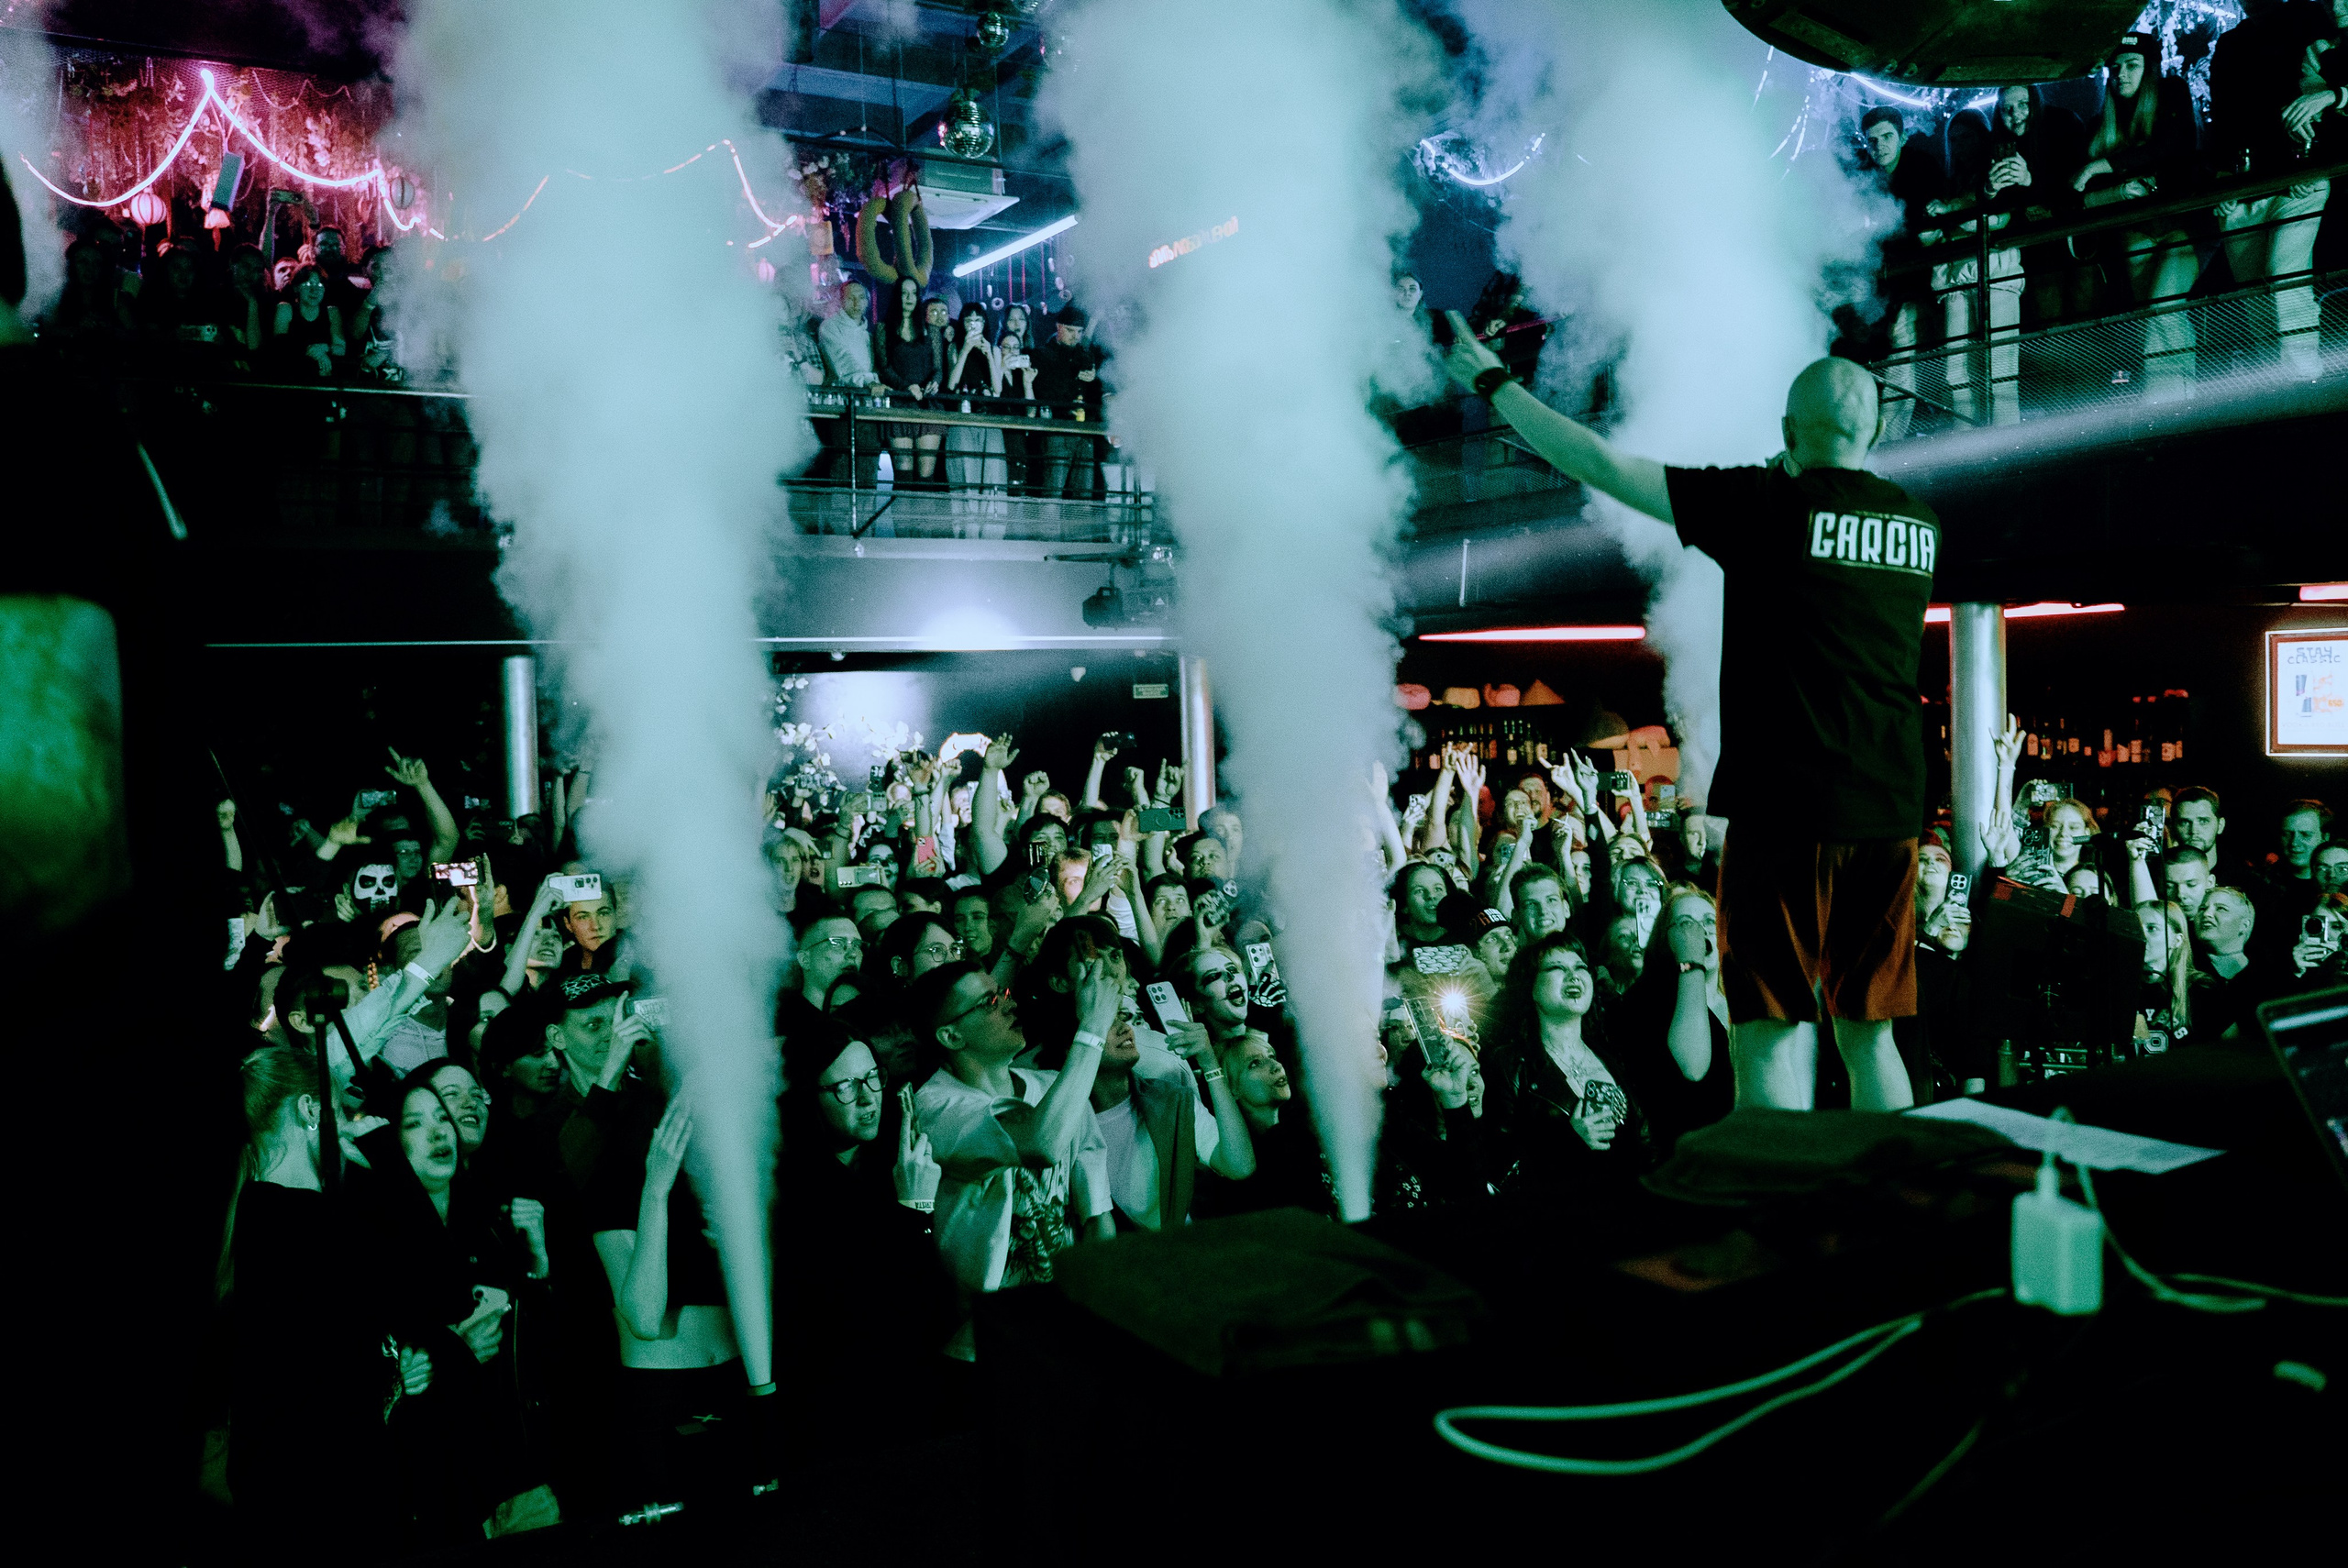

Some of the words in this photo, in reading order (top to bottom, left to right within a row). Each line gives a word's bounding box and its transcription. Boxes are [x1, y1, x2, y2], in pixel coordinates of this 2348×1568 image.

[1811, 512, 1935, 572] GARCIA
[2296, 646, 2332, 658] STAY
[2287, 655, 2341, 664] CLASSIC
